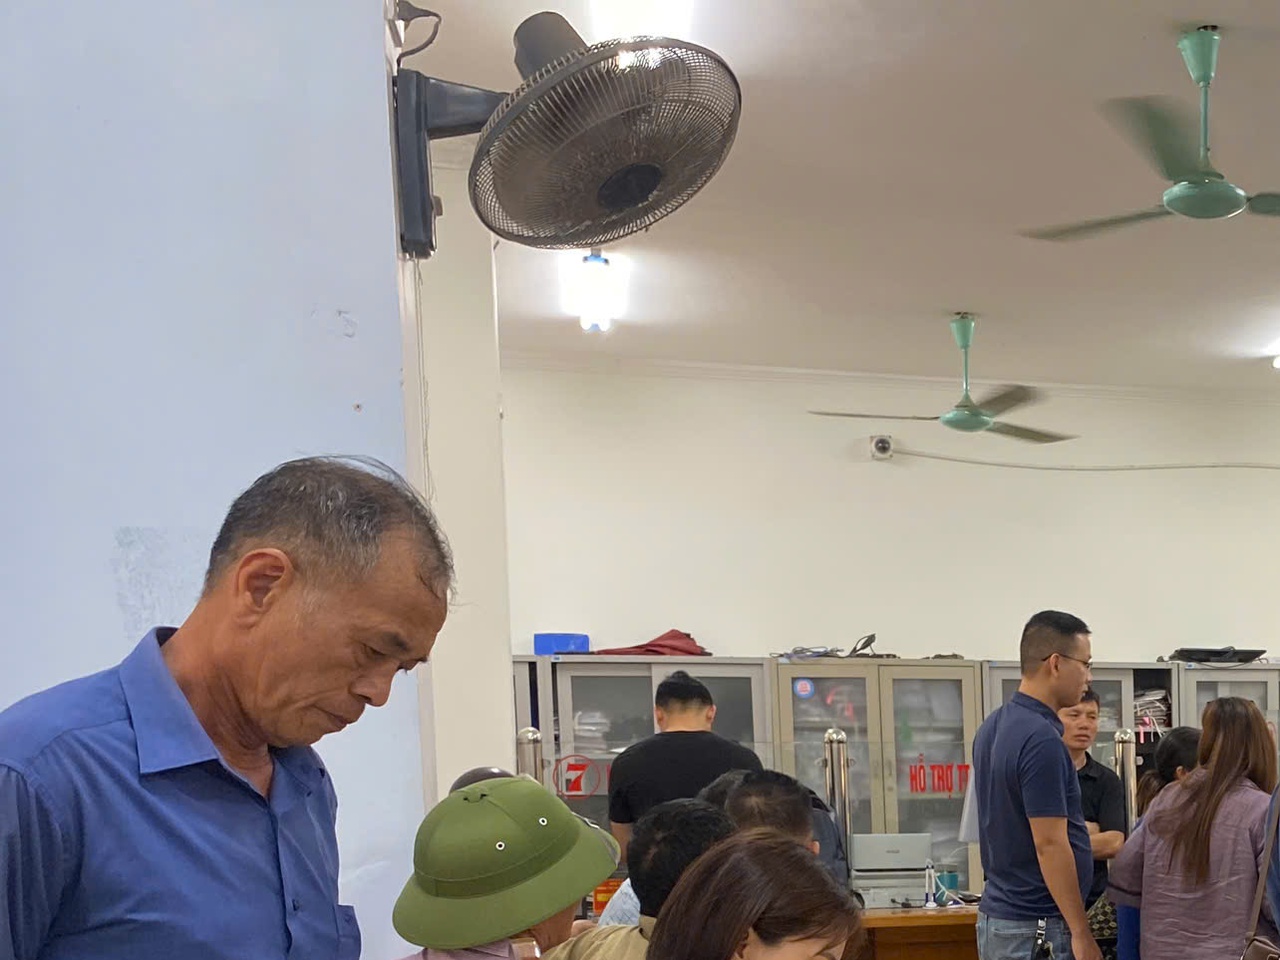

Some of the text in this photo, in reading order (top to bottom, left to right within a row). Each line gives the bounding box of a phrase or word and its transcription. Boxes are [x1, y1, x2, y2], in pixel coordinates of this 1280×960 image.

[567, 763, 590, 793] 7
[909, 752, 927, 793] HỖ
[929, 762, 955, 800] TRỢ
